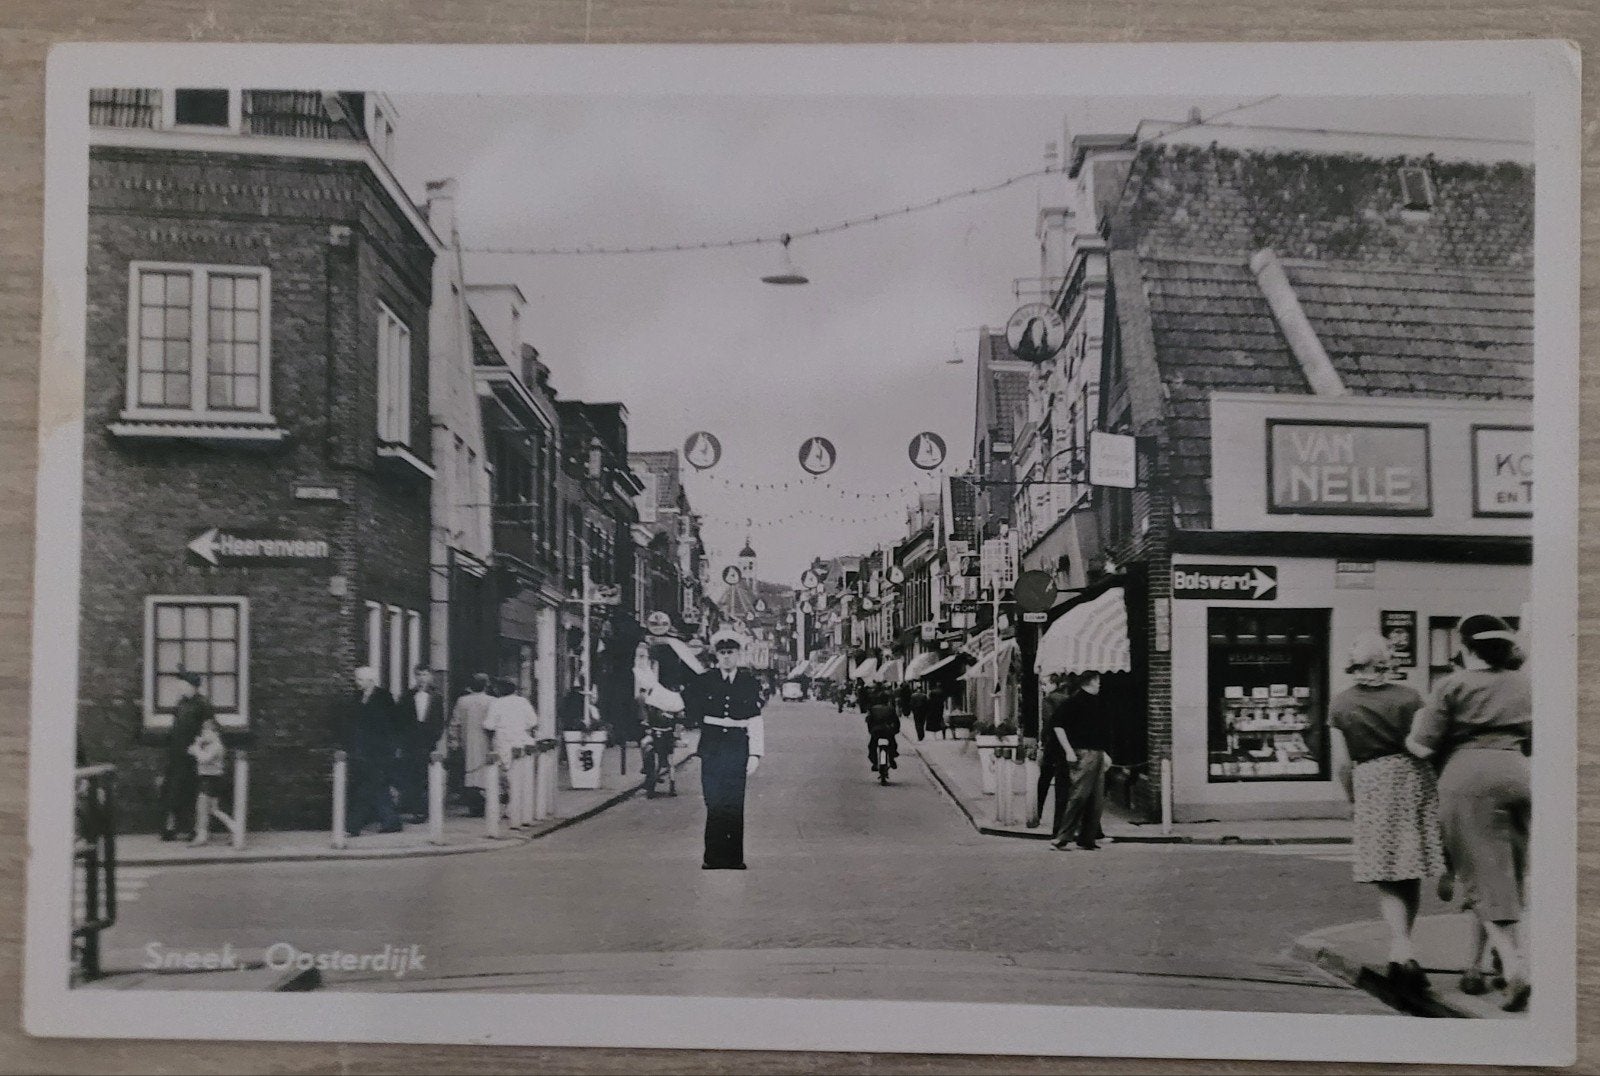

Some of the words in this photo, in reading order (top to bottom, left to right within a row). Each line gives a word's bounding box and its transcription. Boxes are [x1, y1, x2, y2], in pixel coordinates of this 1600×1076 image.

[1291, 431, 1354, 463] VAN
[1290, 464, 1412, 504] NELLE
[1497, 491, 1518, 503] EN
[220, 534, 329, 557] Heerenveen
[1174, 571, 1251, 591] Bolsward
